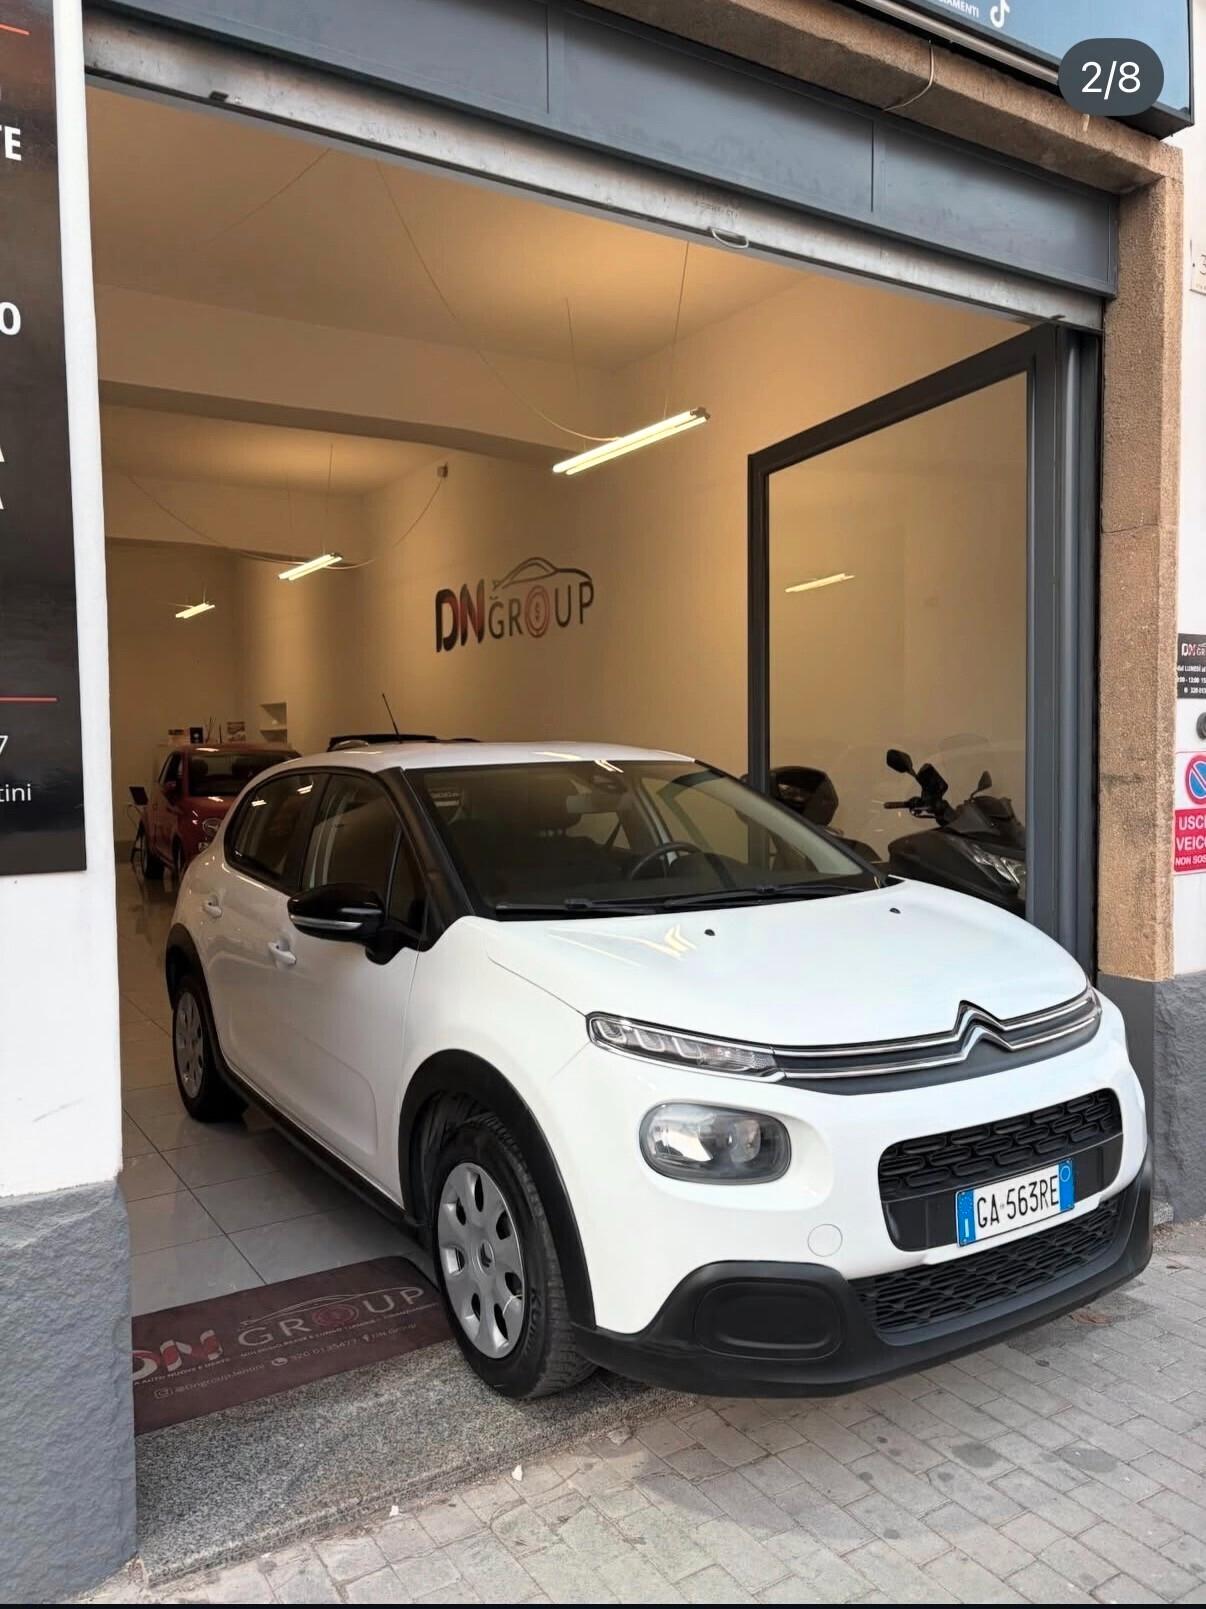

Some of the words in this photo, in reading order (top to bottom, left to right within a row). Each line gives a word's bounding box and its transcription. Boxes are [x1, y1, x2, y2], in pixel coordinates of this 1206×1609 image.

[435, 578, 485, 653] DN
[488, 582, 595, 640] GROUP
[1175, 856, 1191, 866] NON
[976, 1194, 1000, 1228] GA
[1006, 1175, 1059, 1220] 563RE
[237, 1286, 425, 1347] GROUP
